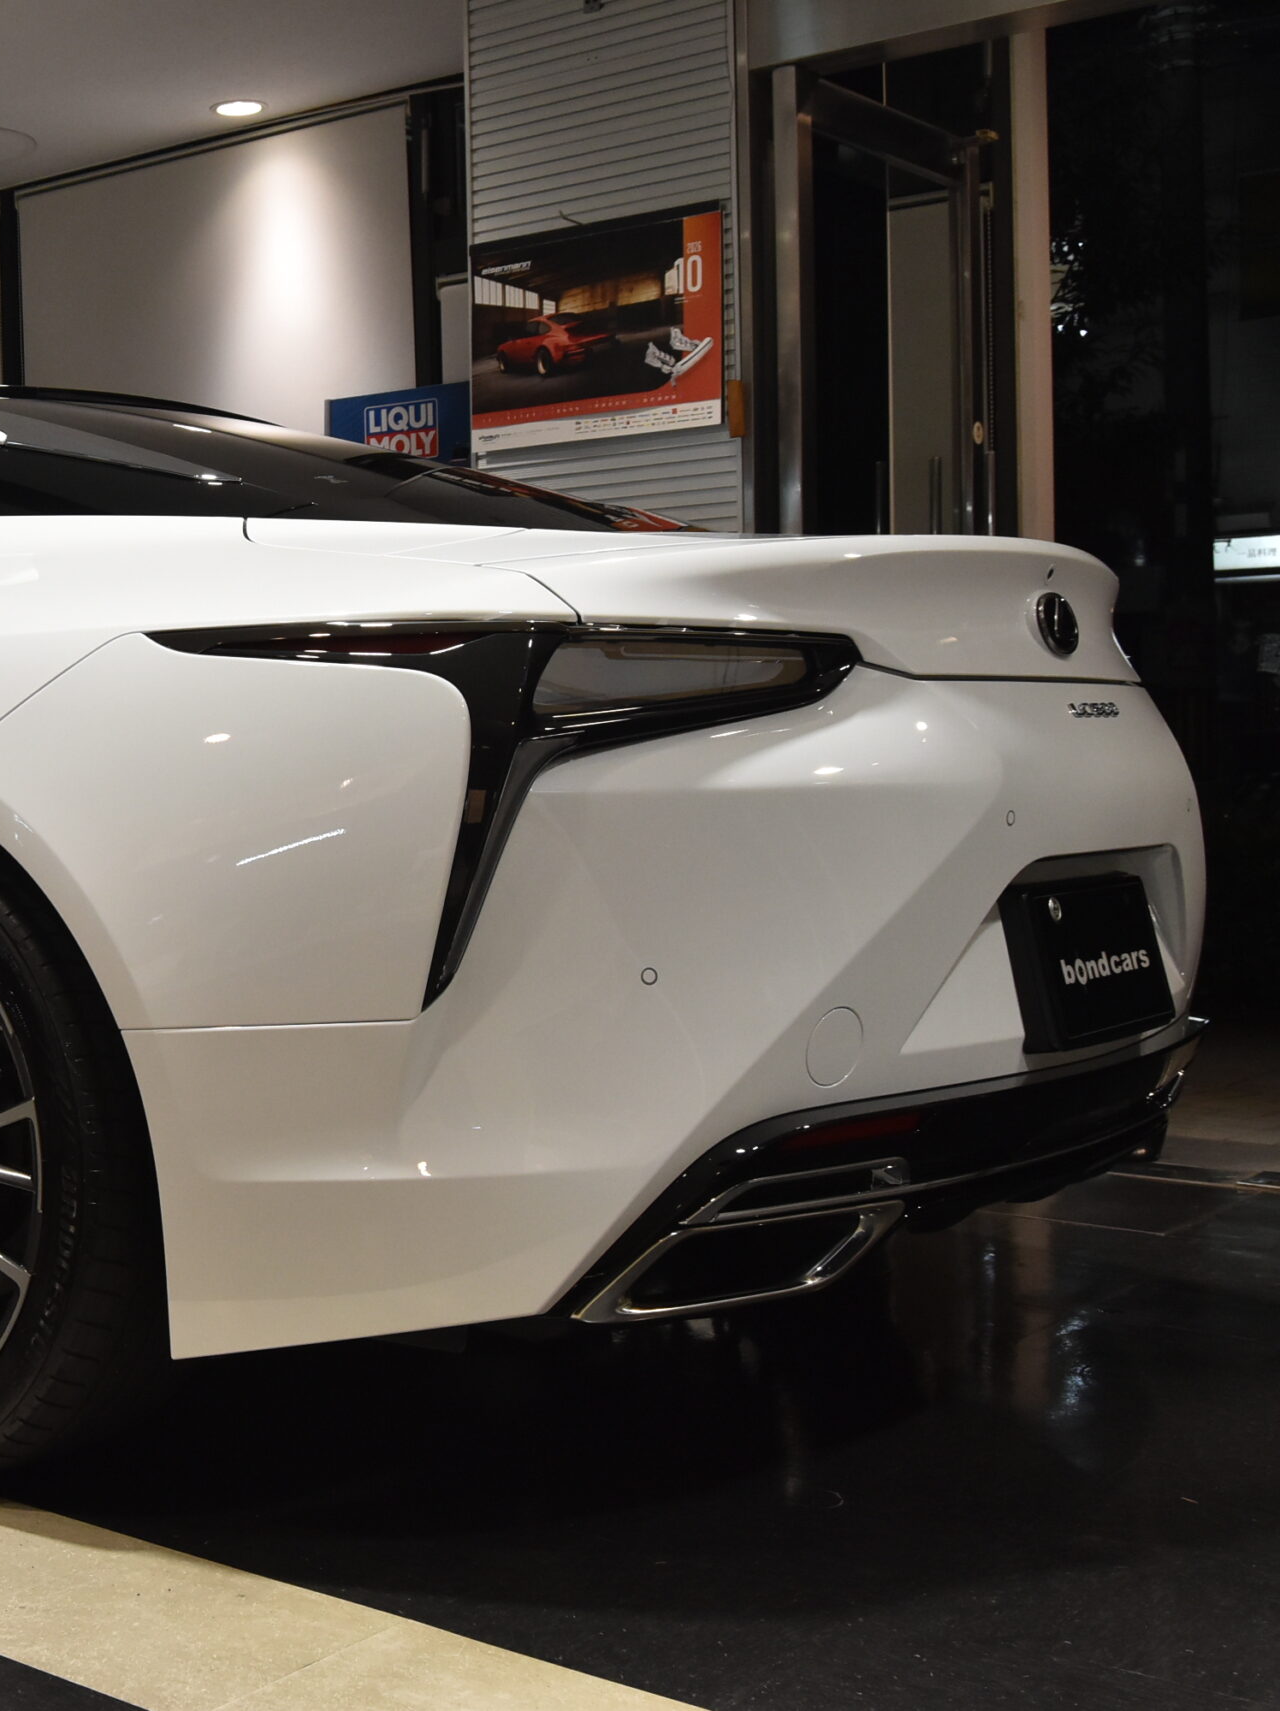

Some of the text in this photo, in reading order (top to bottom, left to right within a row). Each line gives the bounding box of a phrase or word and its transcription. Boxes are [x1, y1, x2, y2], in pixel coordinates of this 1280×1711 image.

[674, 255, 703, 294] 10
[369, 403, 433, 433] LIQUI
[1060, 949, 1151, 985] bondcars
